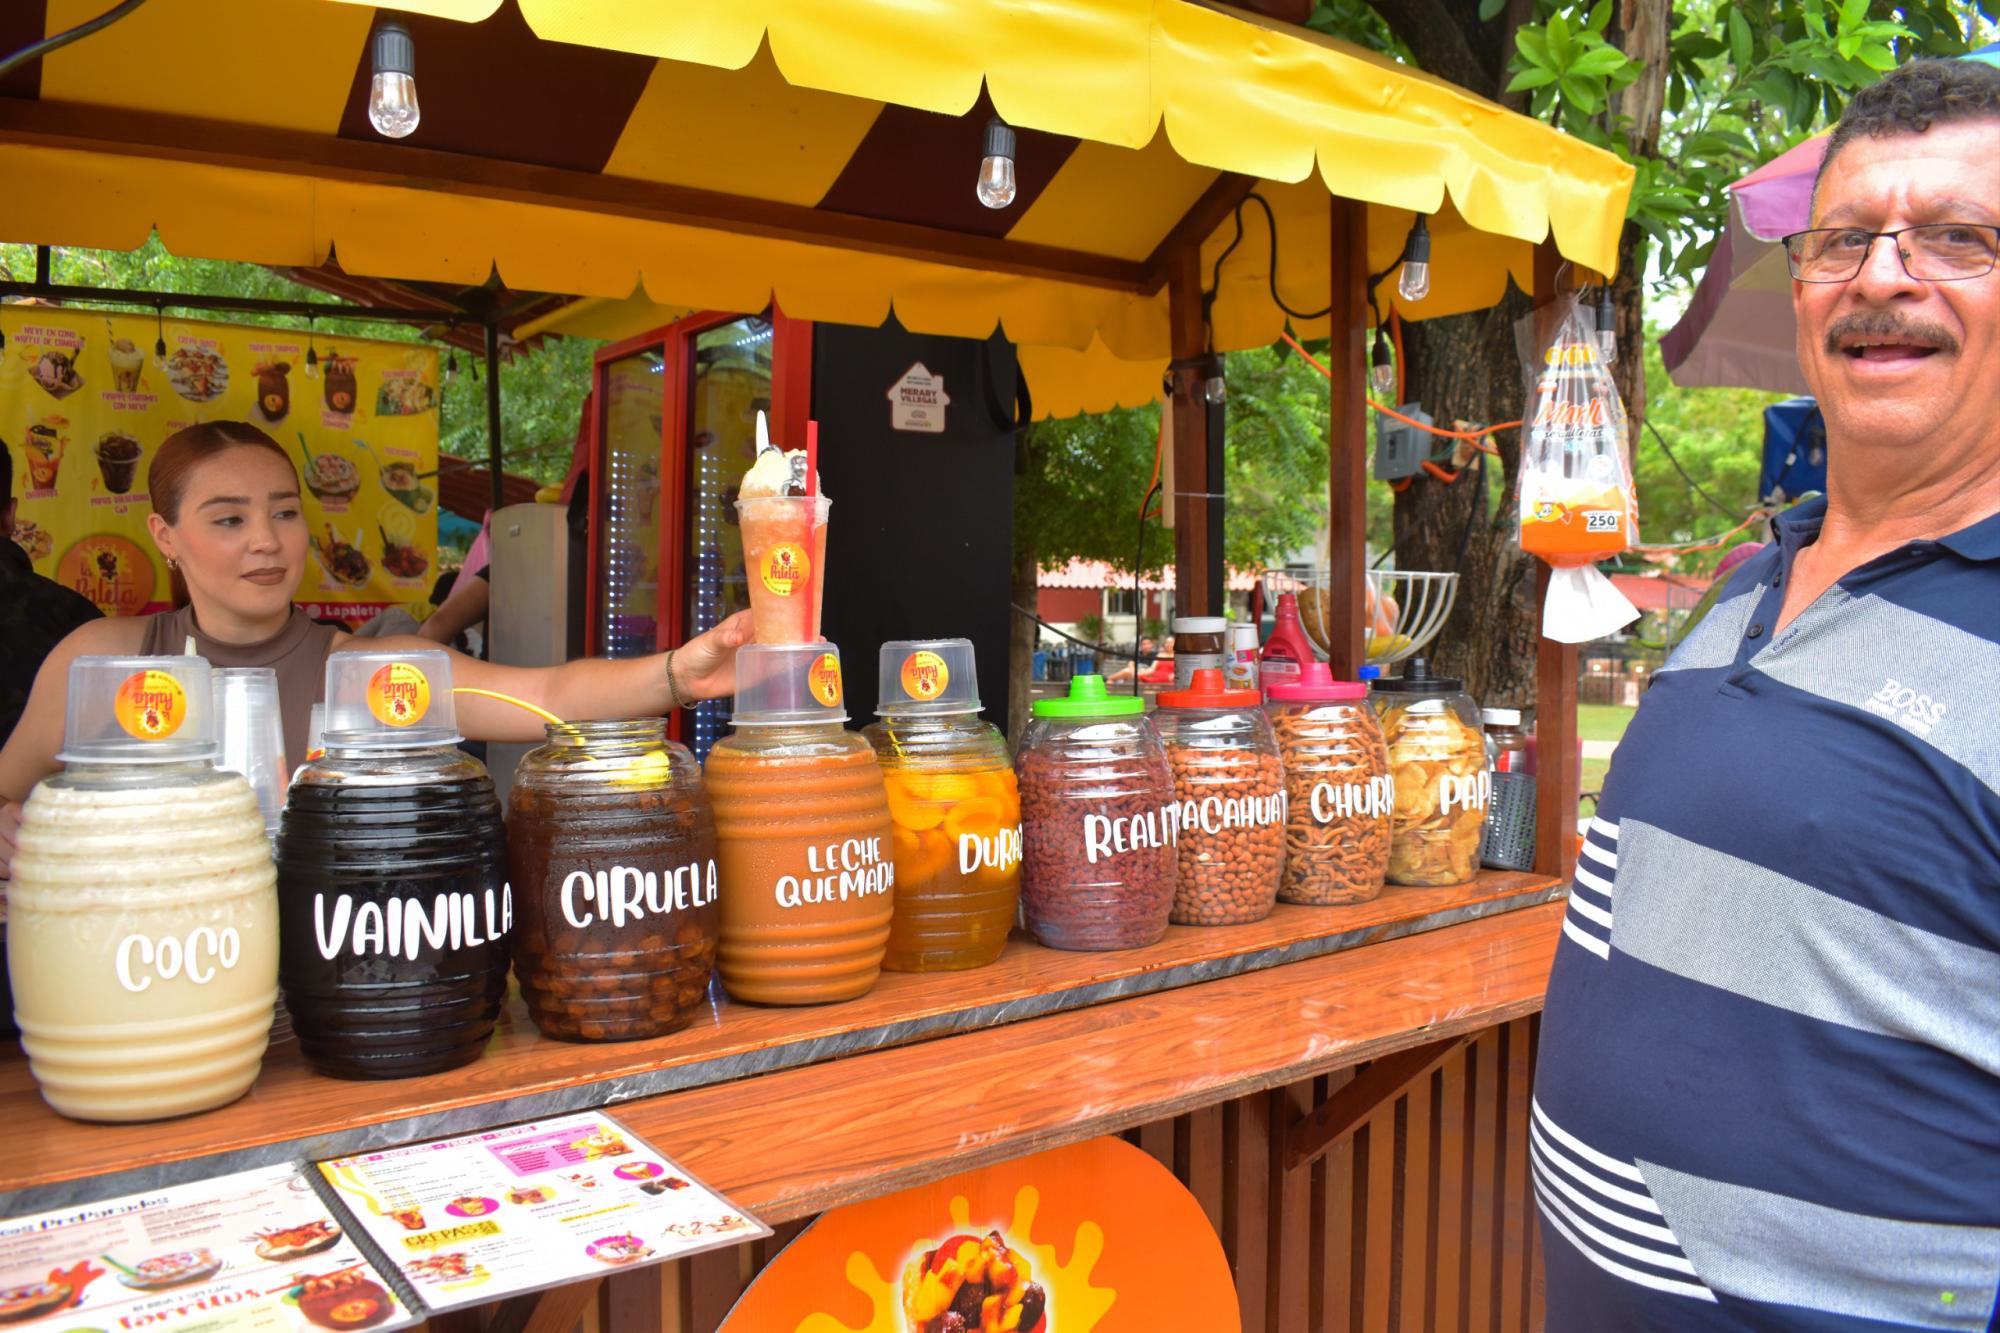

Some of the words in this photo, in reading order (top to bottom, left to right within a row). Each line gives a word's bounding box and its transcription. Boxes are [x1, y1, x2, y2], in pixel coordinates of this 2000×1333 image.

[901, 387, 937, 397] MERARY
[1589, 515, 1616, 527] 250
[1873, 678, 1947, 725] BOSS
[807, 837, 881, 873] LECHE
[560, 859, 718, 928] CIRUELA
[775, 861, 894, 908] QUEMADA
[314, 882, 513, 961] VAINILLA
[115, 926, 241, 993] COCO
